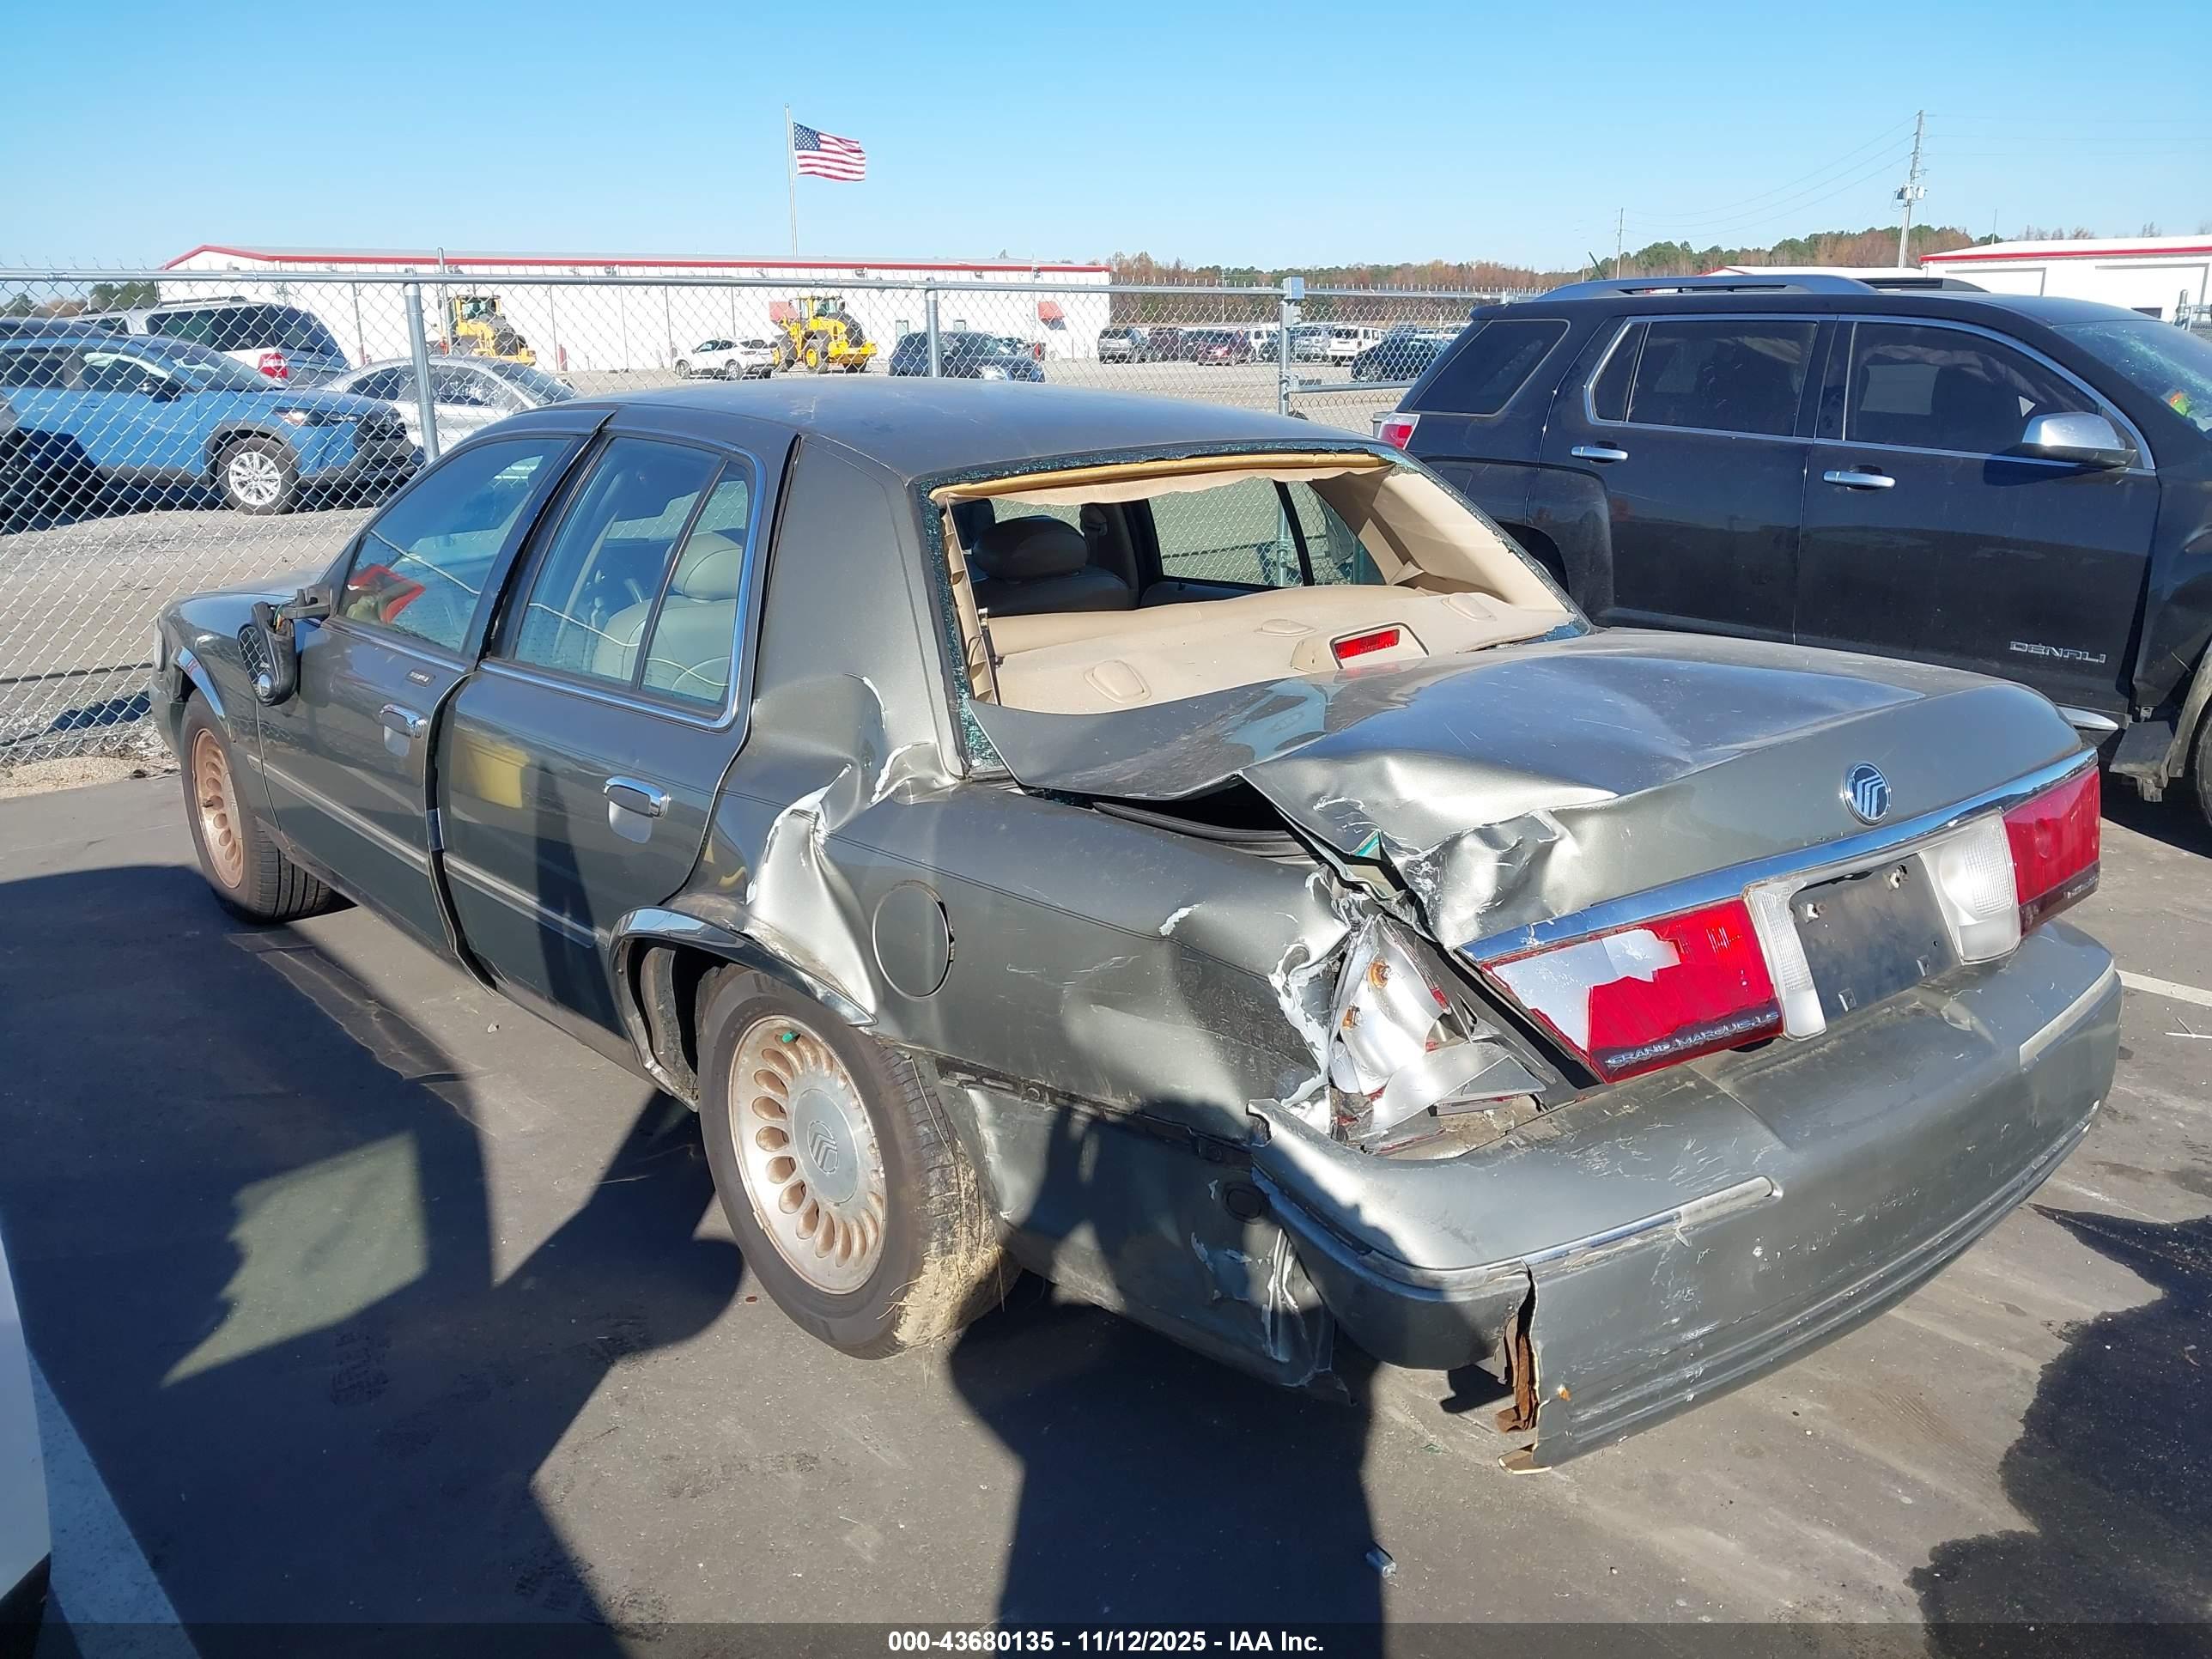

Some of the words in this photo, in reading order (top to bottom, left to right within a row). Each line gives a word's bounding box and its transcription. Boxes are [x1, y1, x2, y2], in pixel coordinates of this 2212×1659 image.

[2009, 641, 2106, 664] DENALI
[1606, 1044, 1670, 1066] GRAND
[1674, 1019, 1754, 1047] MARQUIS
[1755, 1011, 1779, 1024] LS
